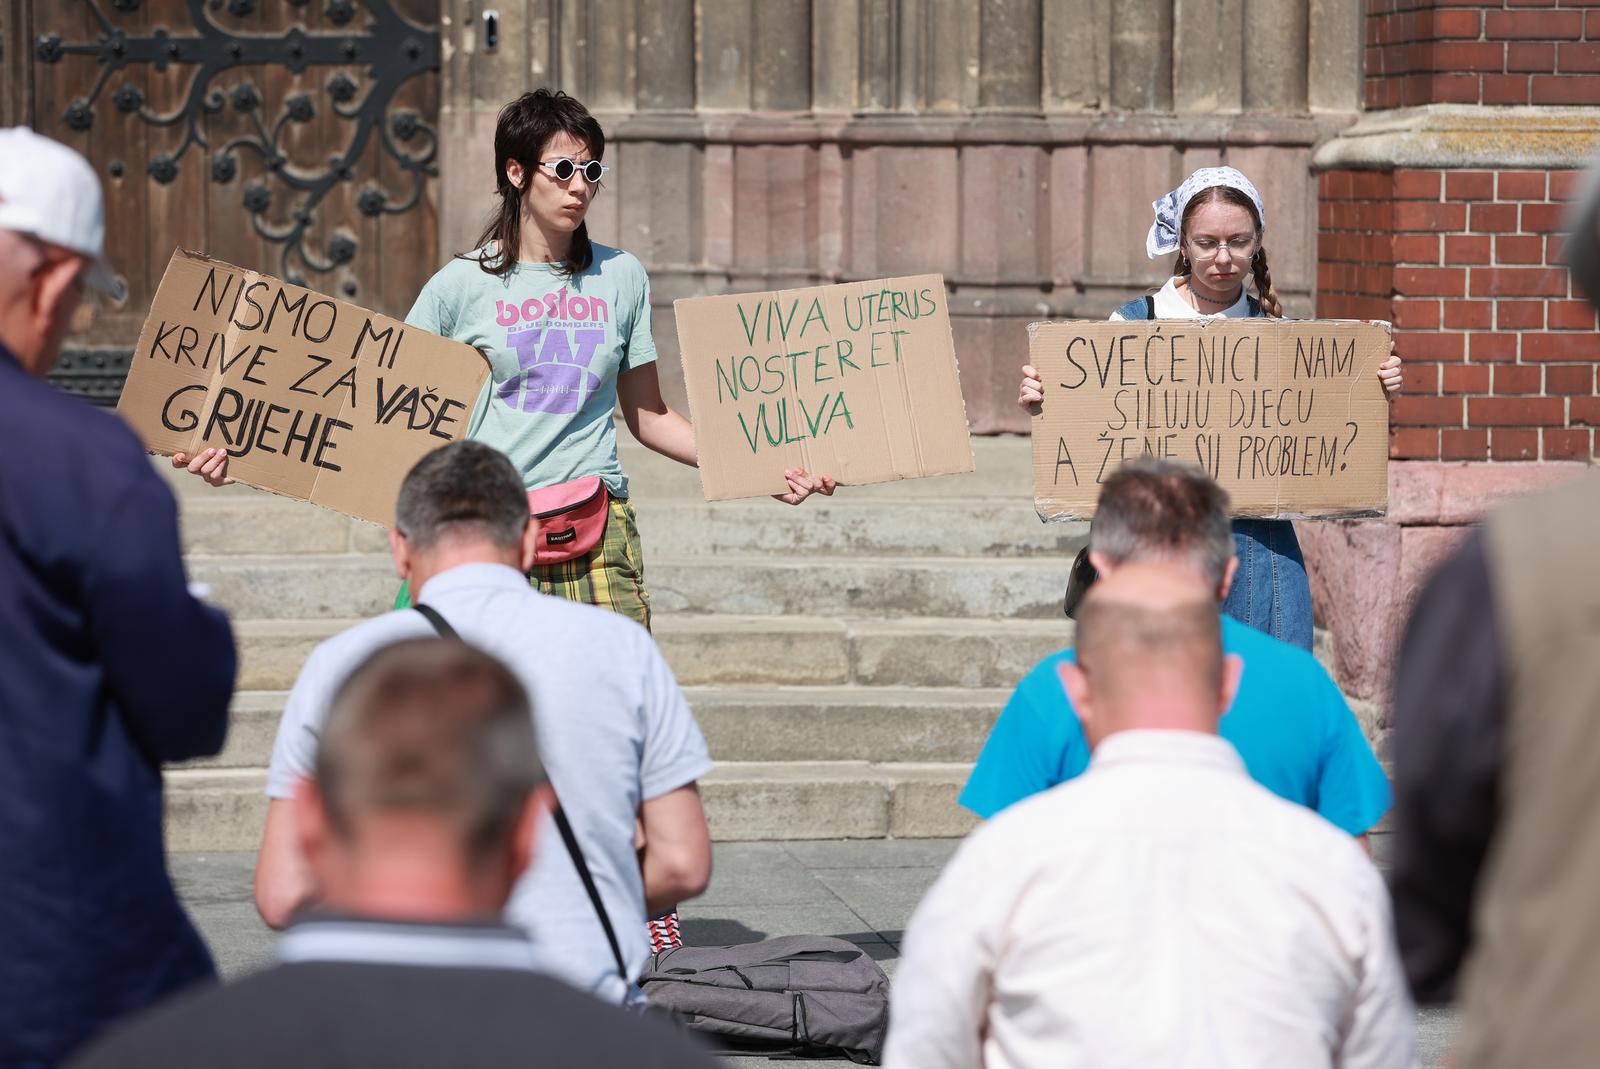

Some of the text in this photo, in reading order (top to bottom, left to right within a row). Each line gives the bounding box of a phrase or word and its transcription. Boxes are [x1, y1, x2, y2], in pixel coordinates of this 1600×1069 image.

[193, 267, 405, 369] NISMO MI
[495, 286, 609, 327] boston
[737, 288, 937, 347] VIVA UTERUS
[150, 320, 467, 440] KRIVE ZA VAŠE
[716, 330, 911, 404] NOSTER ET
[1060, 326, 1356, 390] SVEĆENICI NAM
[161, 384, 354, 472] GRIJEHE
[737, 391, 854, 454] VULVA
[1107, 388, 1315, 430] SILUJU DJECU
[1054, 436, 1079, 486] A
[1195, 433, 1221, 481] SU
[1237, 422, 1359, 481] PROBLEM?
